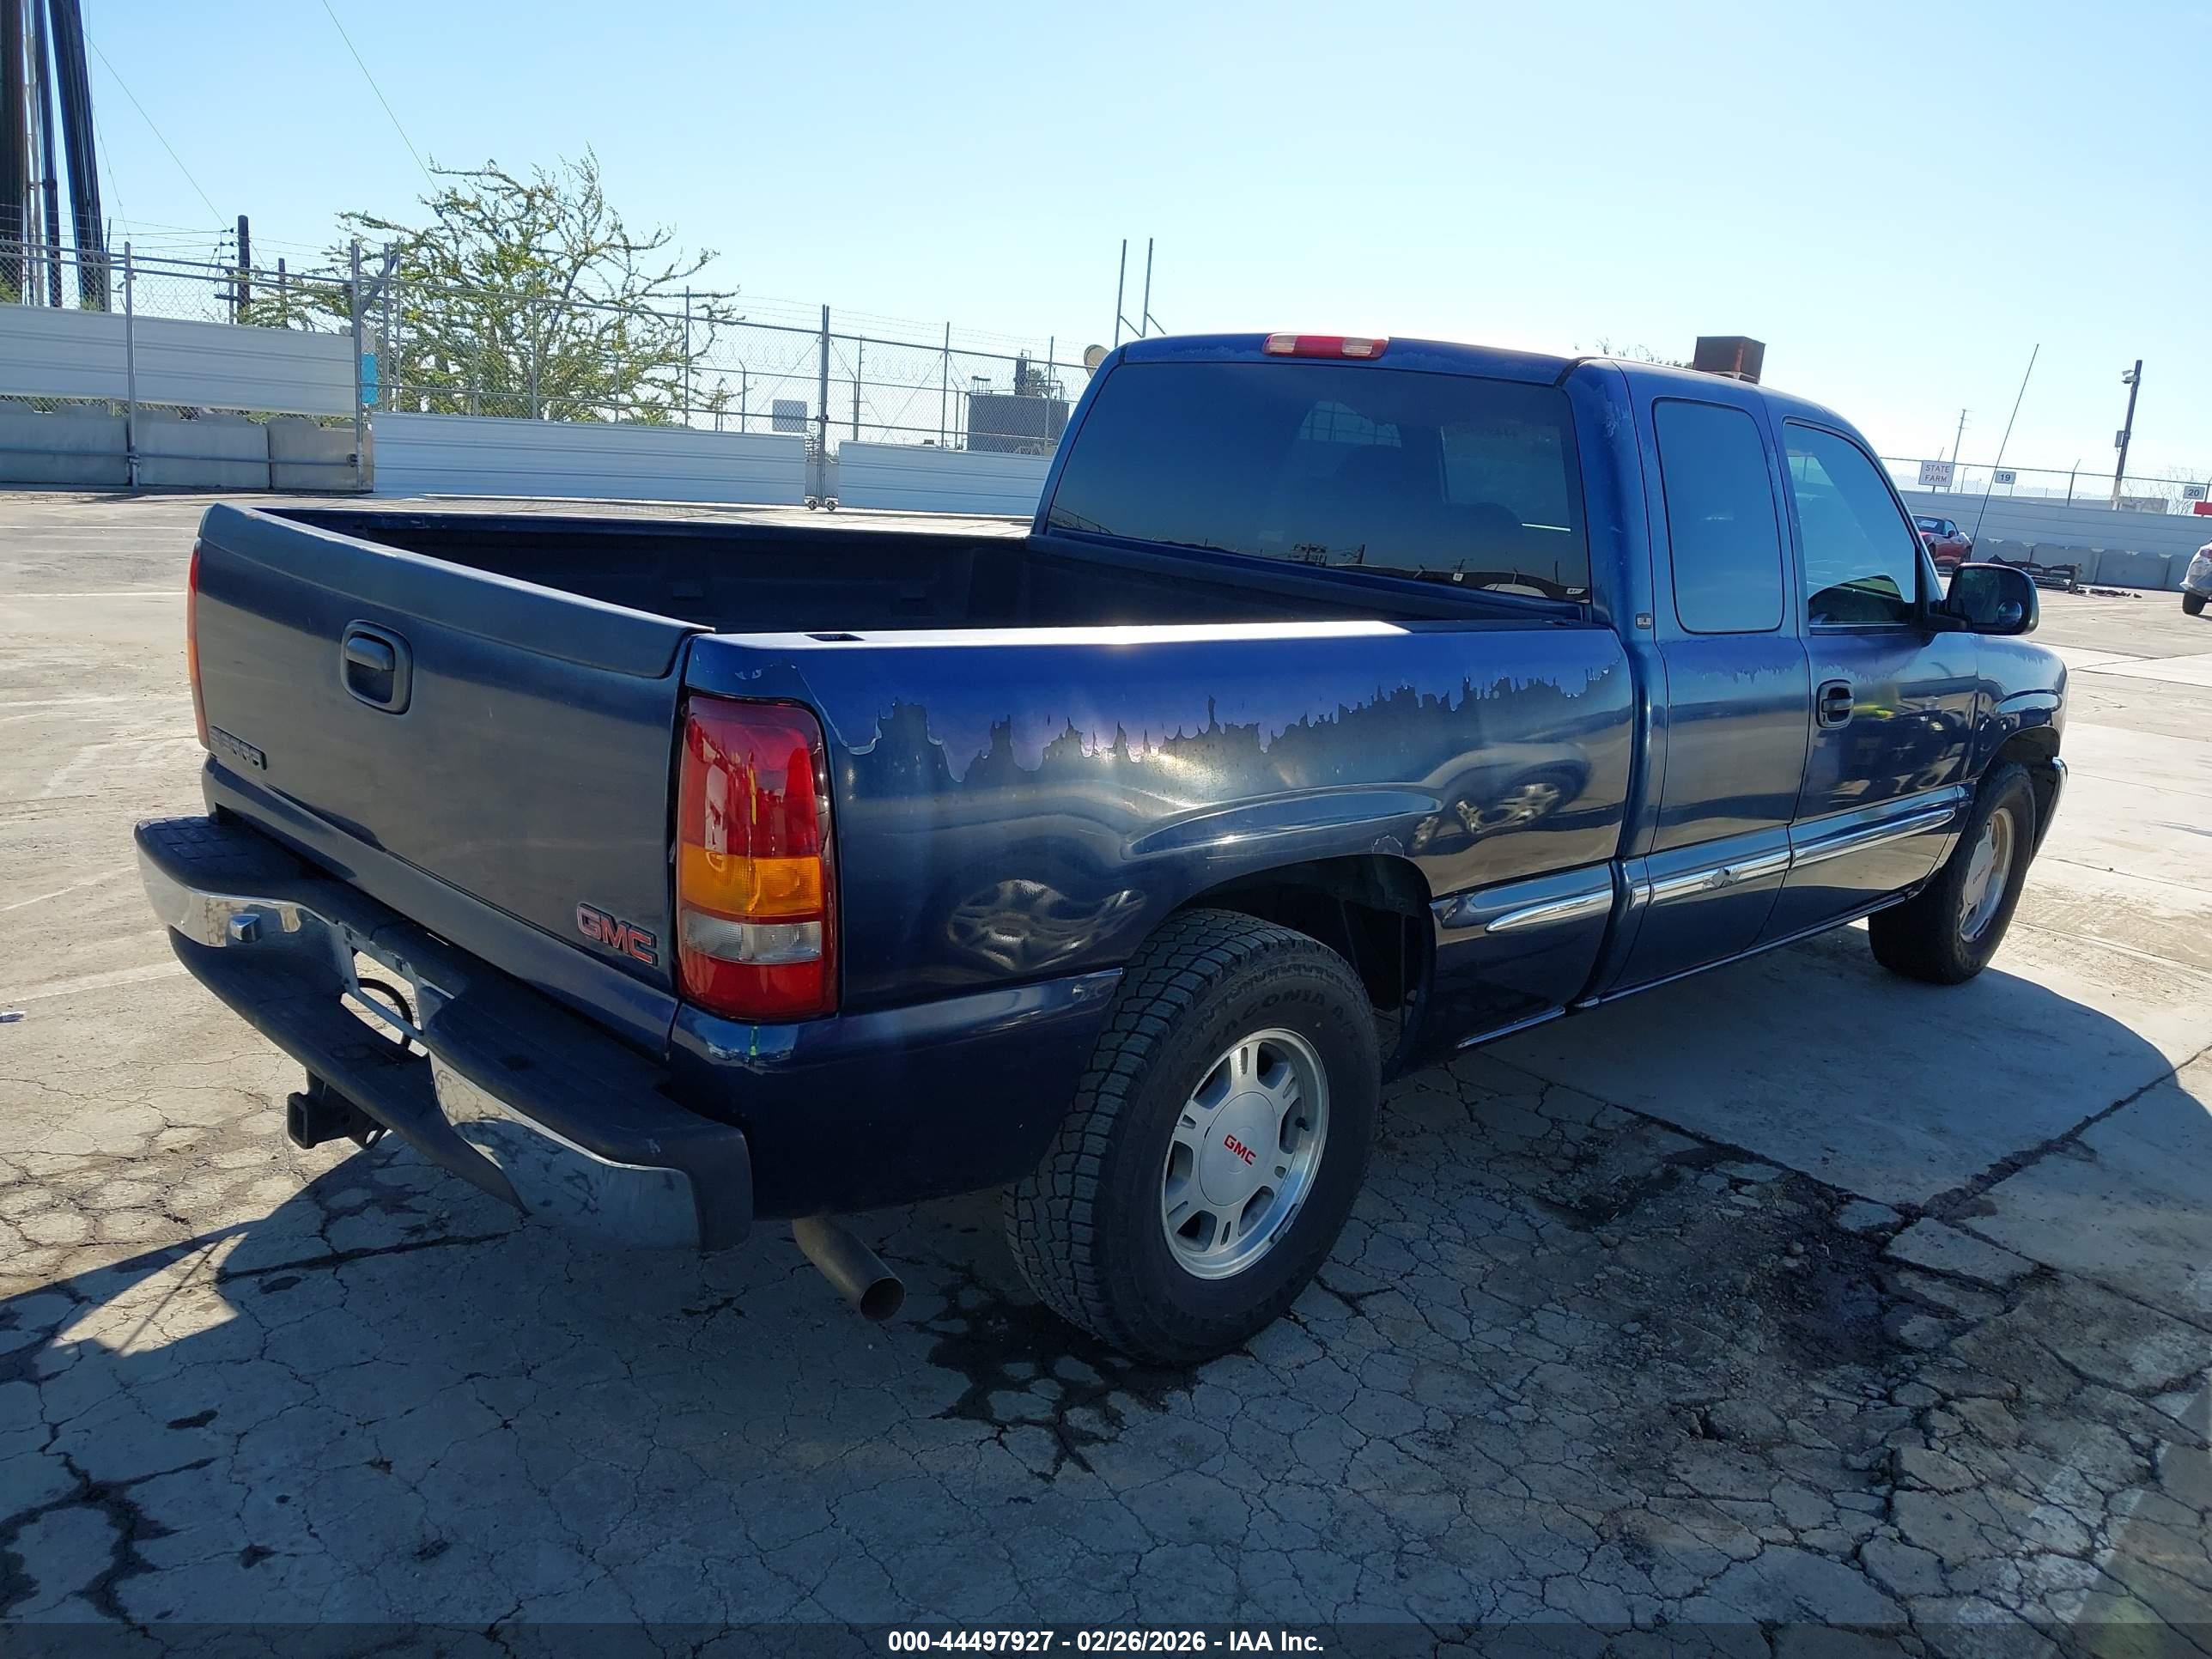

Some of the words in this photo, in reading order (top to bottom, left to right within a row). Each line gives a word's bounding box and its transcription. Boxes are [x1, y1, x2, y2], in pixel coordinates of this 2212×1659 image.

[1924, 474, 1948, 483] FARM
[1925, 465, 1950, 473] STATE
[577, 902, 657, 967] GMC
[1224, 1133, 1257, 1166] GMC
